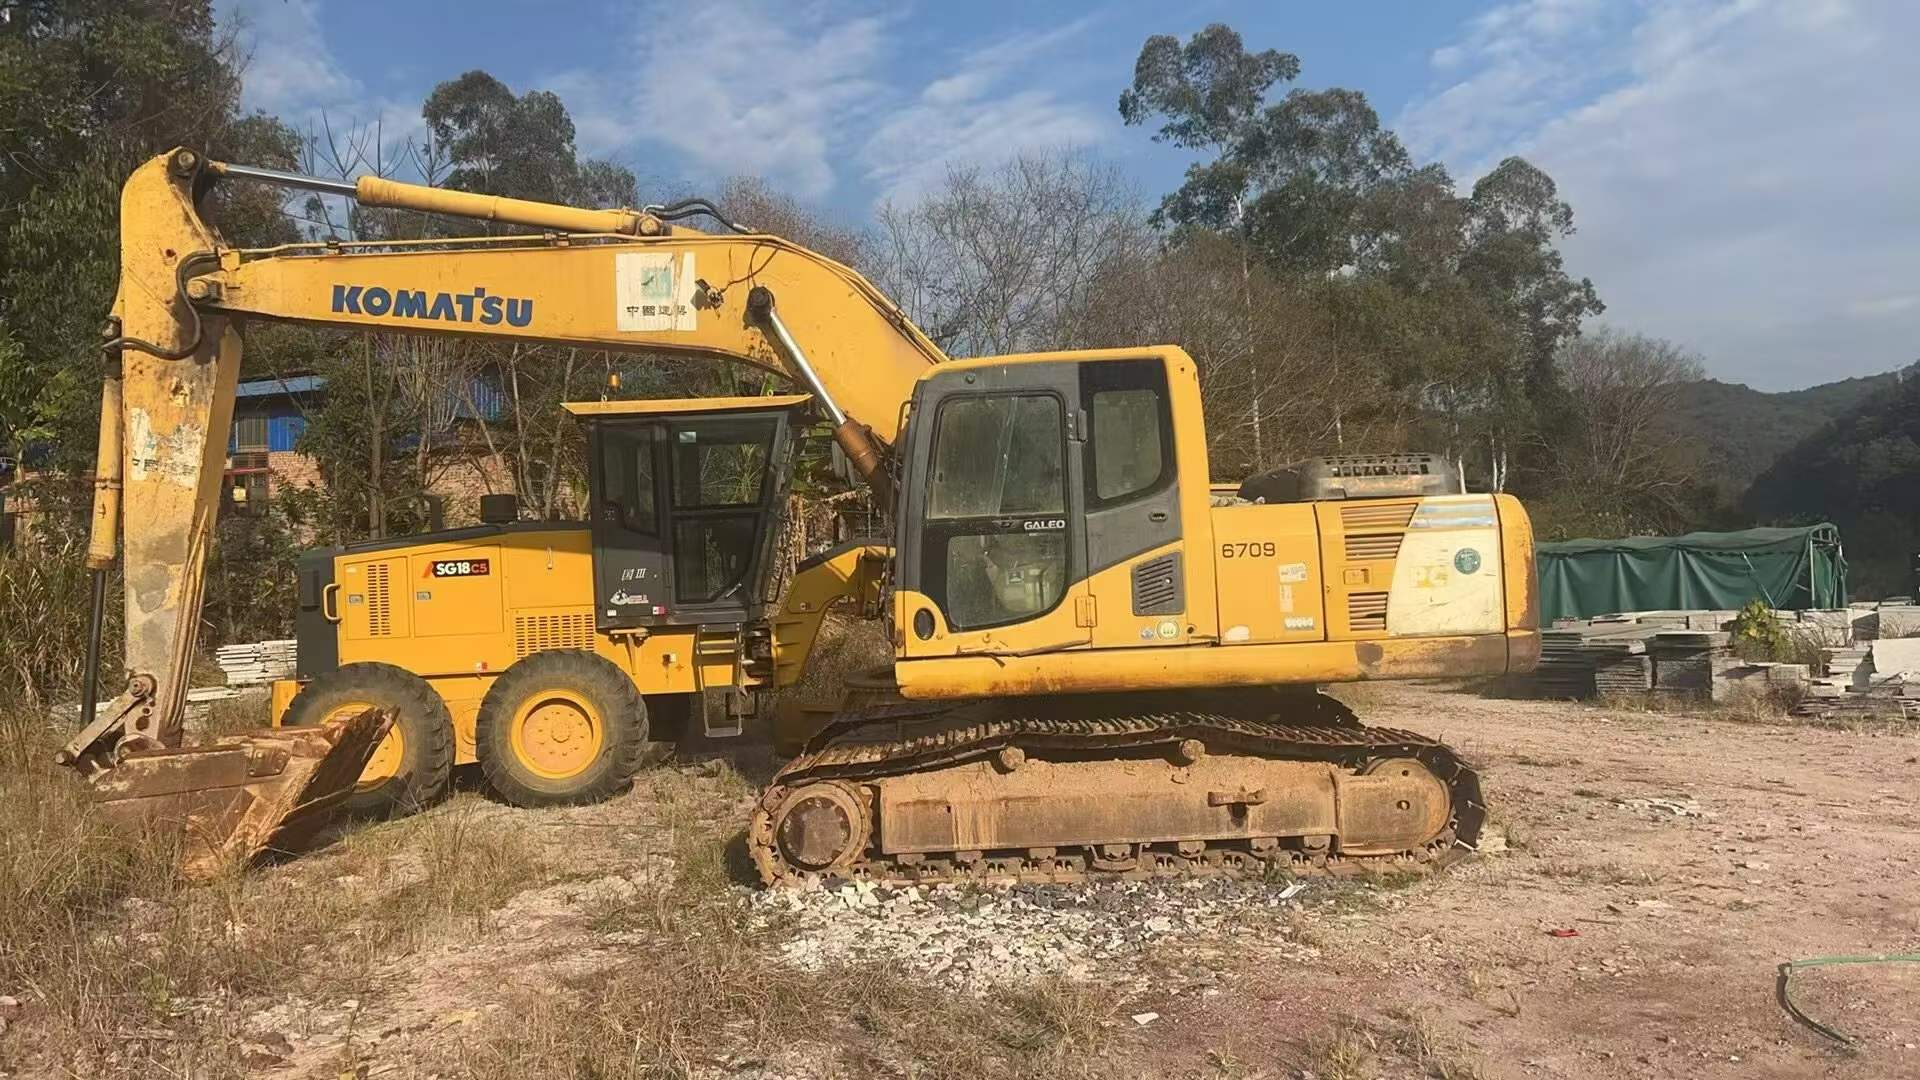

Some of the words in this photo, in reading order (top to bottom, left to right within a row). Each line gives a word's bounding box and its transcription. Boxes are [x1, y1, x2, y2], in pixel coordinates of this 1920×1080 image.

[332, 285, 533, 327] KOMATSU
[1023, 519, 1066, 531] GALEO
[1222, 542, 1276, 559] 6709
